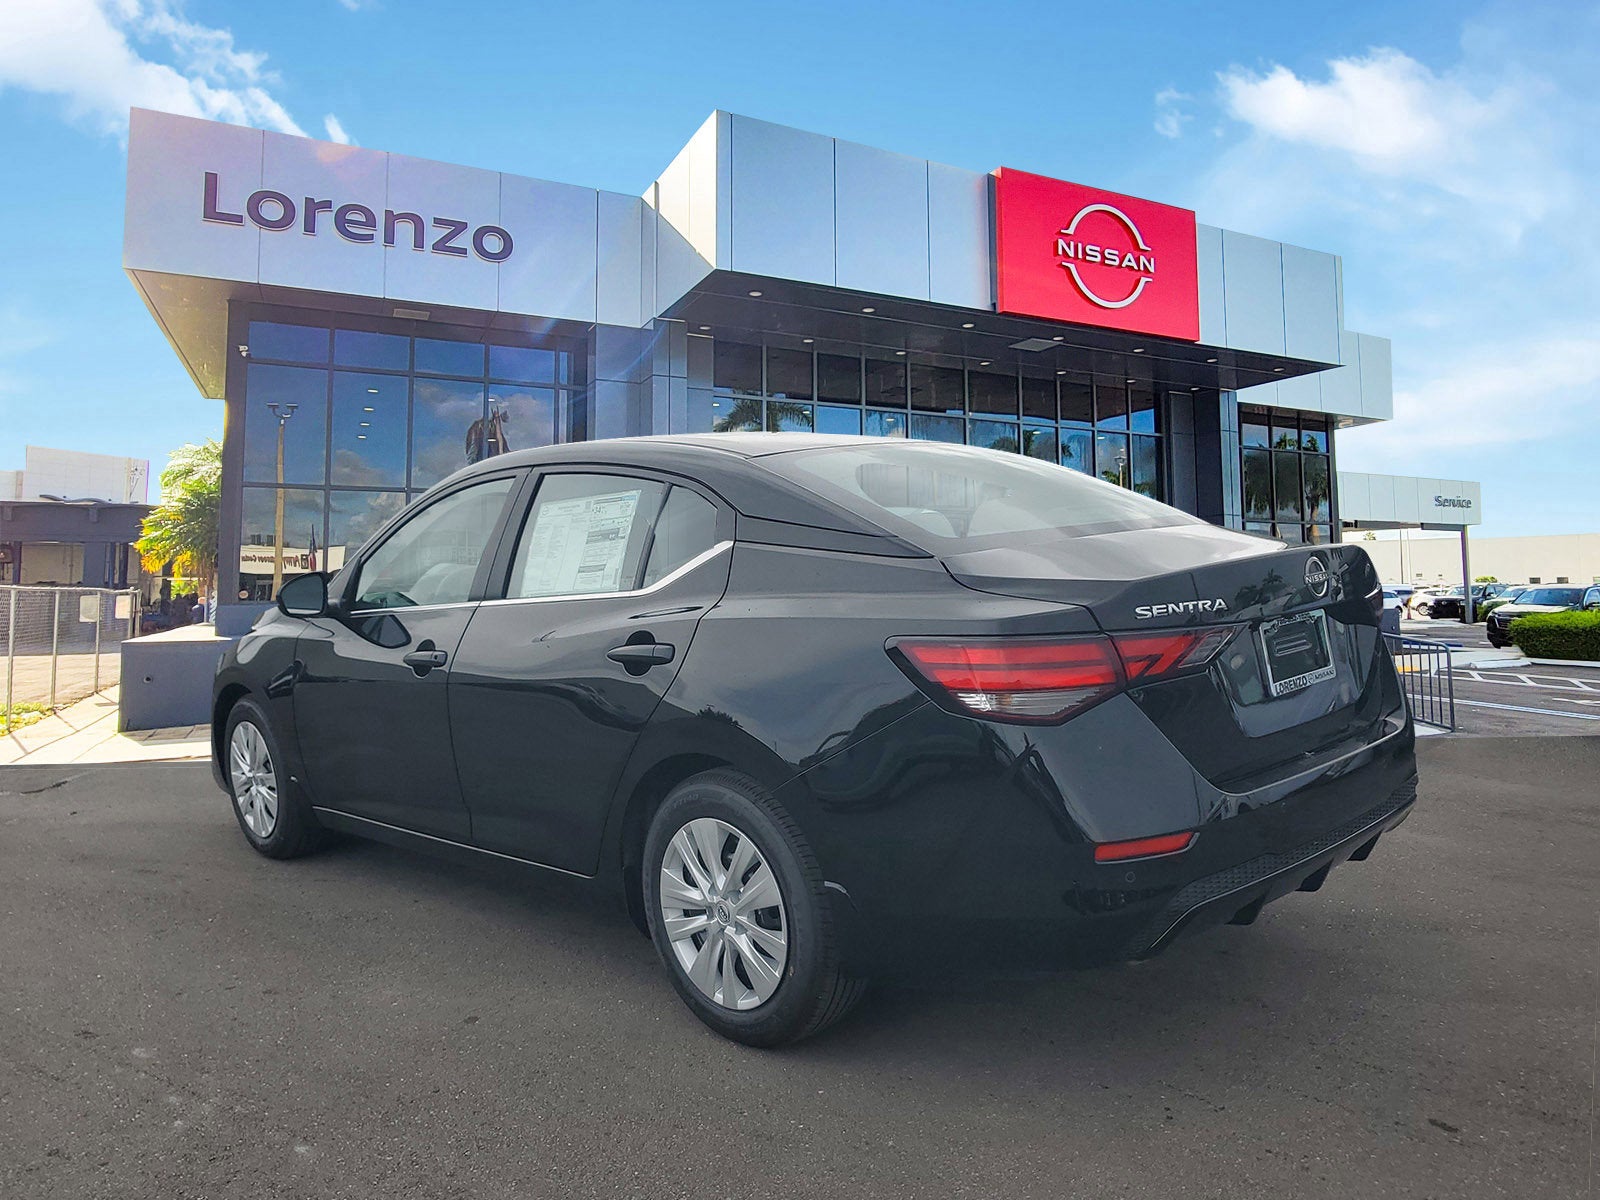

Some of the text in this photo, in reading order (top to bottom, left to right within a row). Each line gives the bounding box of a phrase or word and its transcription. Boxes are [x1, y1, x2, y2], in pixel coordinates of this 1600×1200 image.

[203, 171, 514, 262] Lorenzo
[1057, 238, 1155, 273] NISSAN
[1434, 495, 1472, 509] Service
[1135, 598, 1229, 620] SENTRA
[1274, 675, 1308, 695] LORENZO
